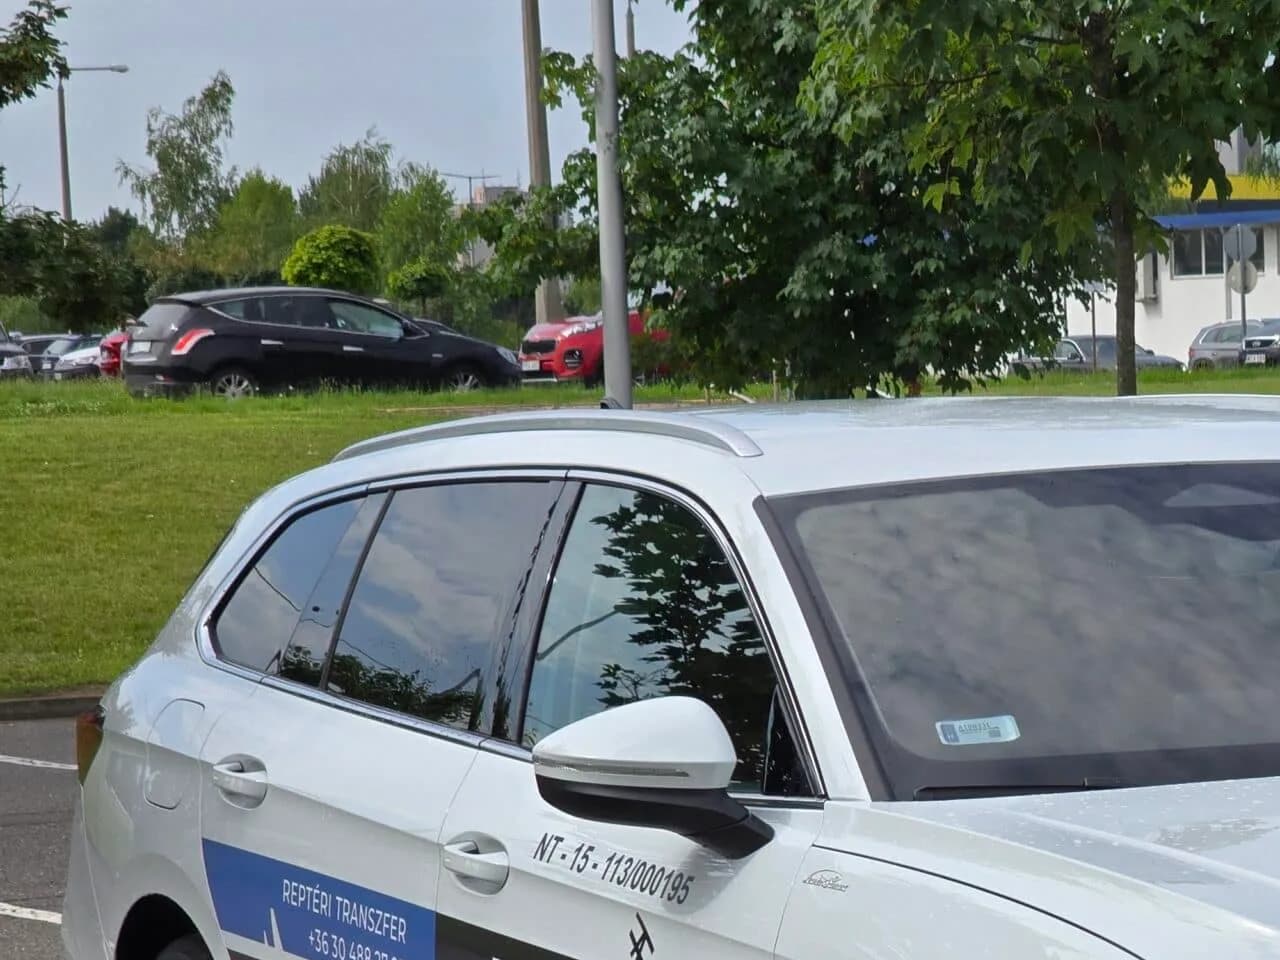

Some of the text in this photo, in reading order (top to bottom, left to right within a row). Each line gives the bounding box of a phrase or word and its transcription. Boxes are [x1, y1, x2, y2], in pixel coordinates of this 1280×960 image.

[533, 833, 565, 863] NT
[570, 843, 595, 873] 15
[601, 852, 695, 904] 113/000195
[282, 879, 406, 945] REPTÉRI TRANSZFER
[309, 929, 329, 955] +36
[331, 934, 346, 960] 30
